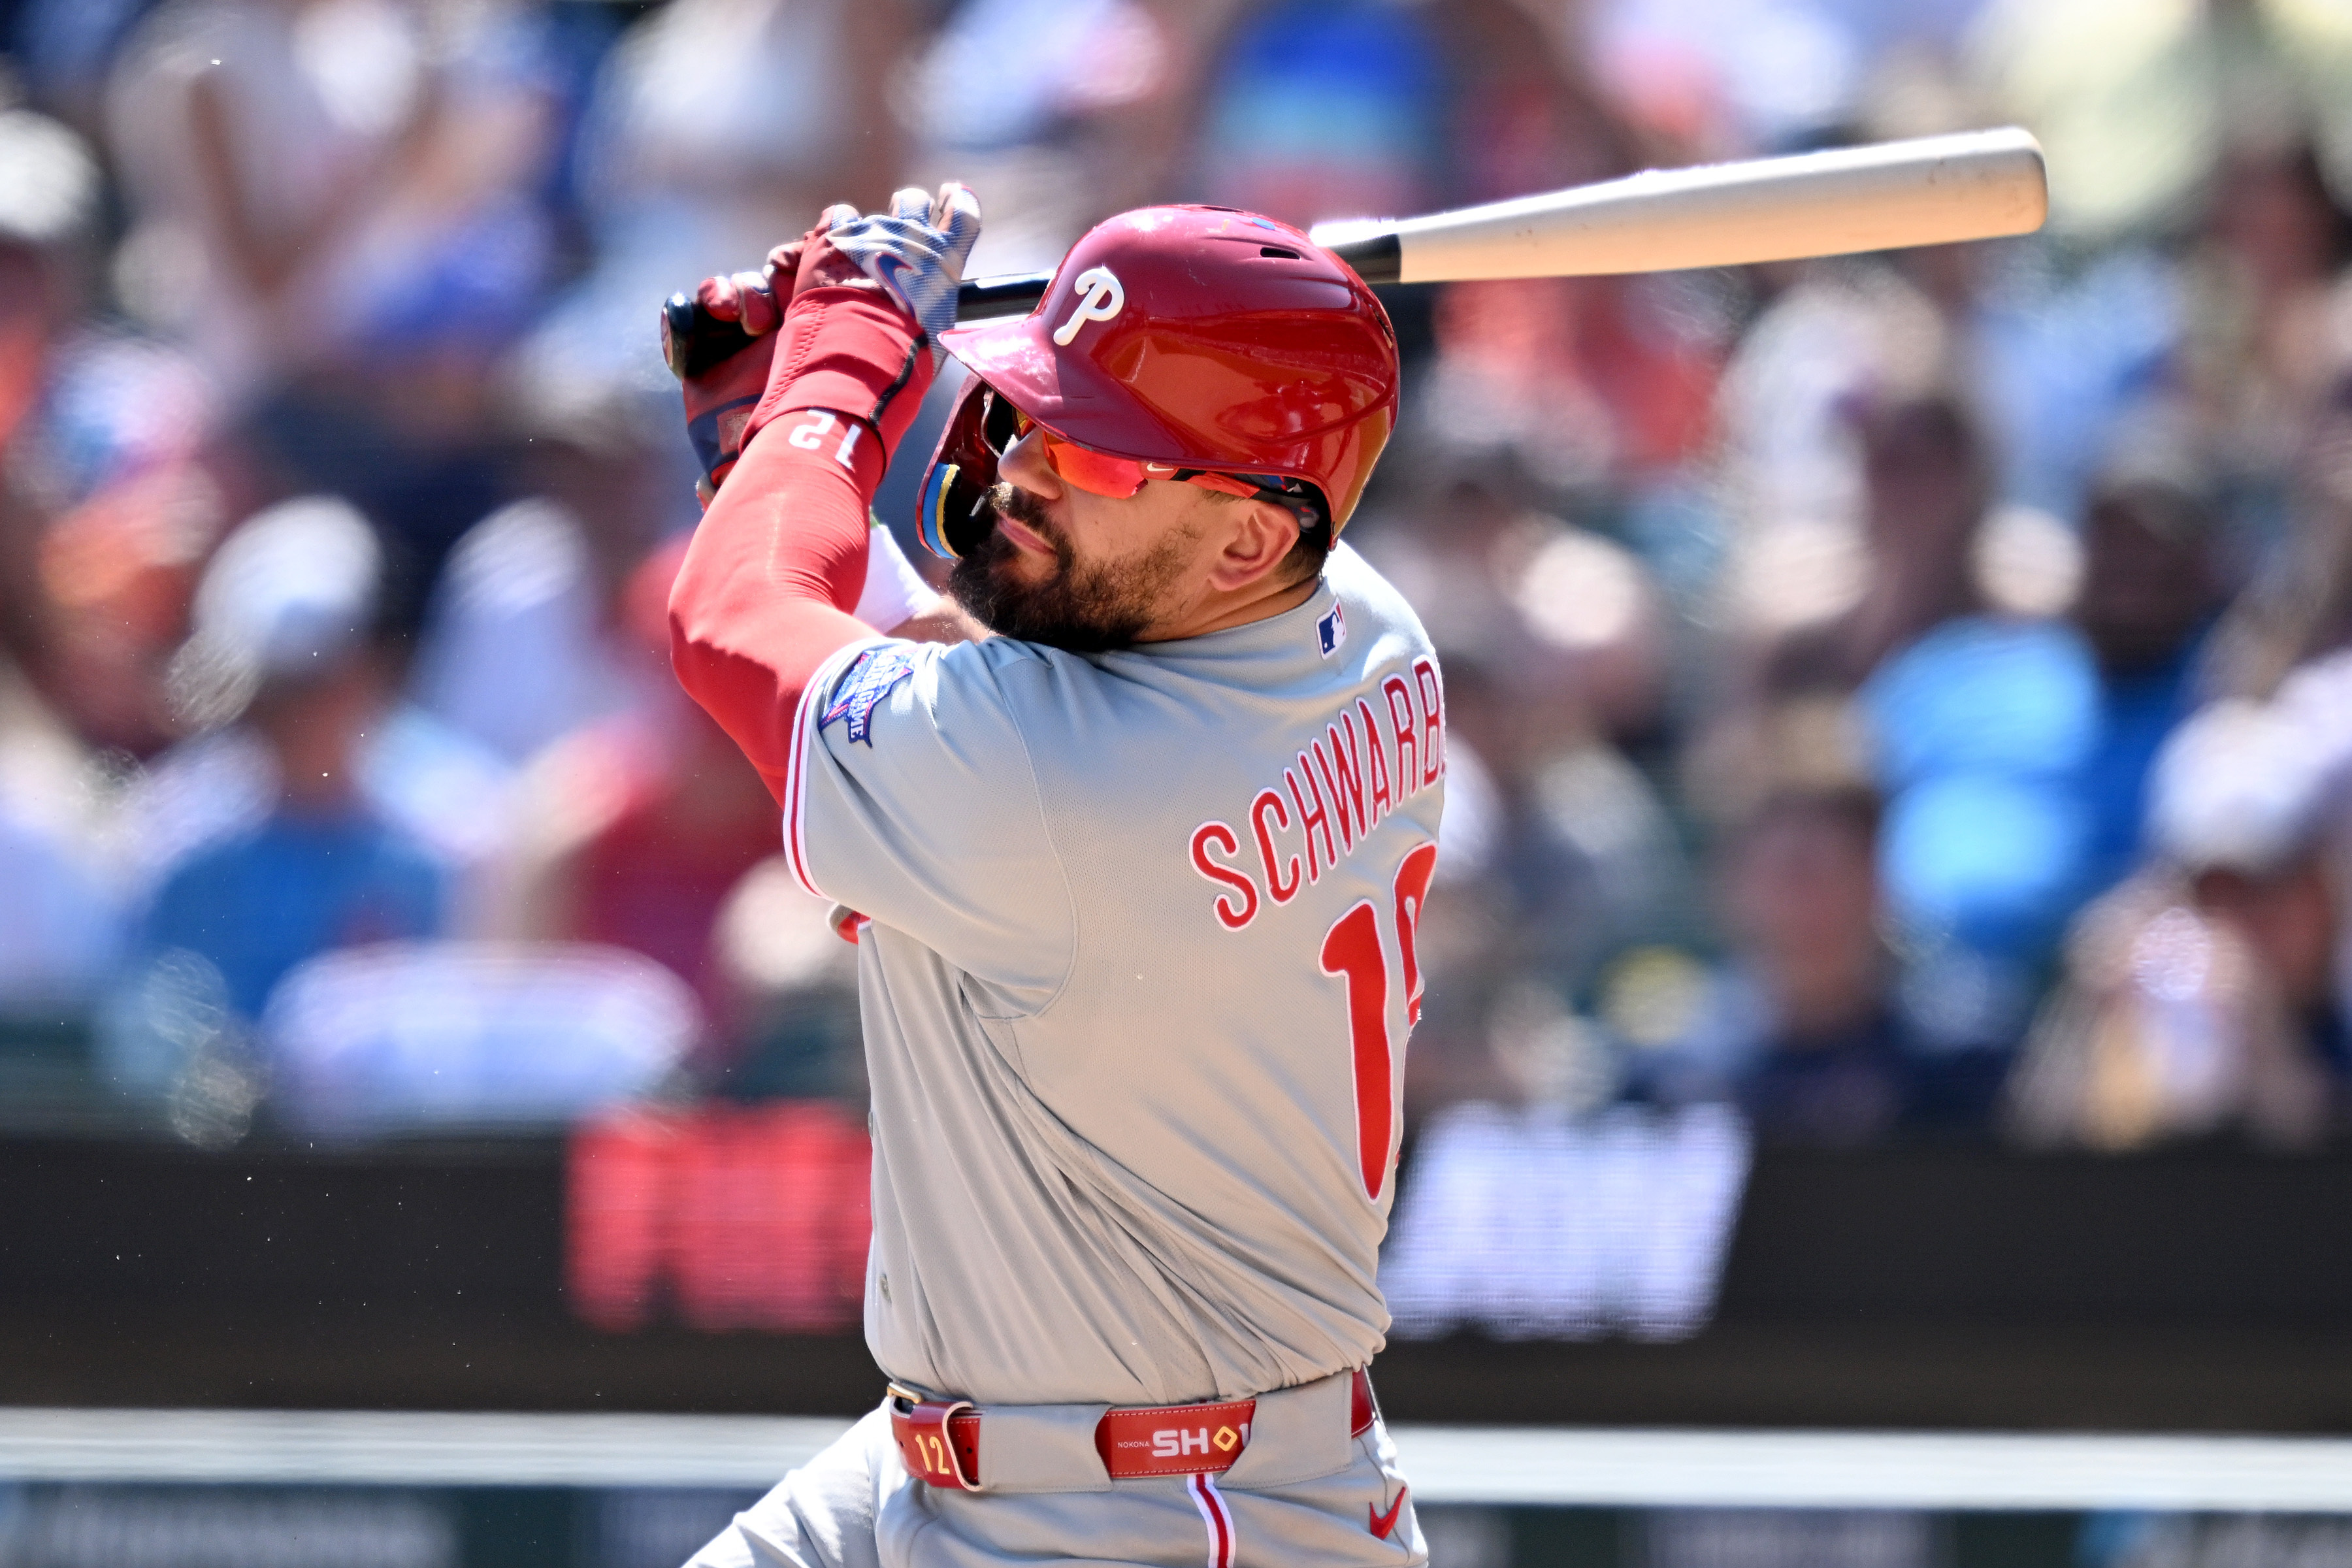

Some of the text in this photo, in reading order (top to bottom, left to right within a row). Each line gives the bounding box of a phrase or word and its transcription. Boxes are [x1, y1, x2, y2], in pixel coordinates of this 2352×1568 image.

[1053, 267, 1124, 346] P
[1189, 655, 1447, 932] SCHWARB
[915, 1434, 950, 1475] 12
